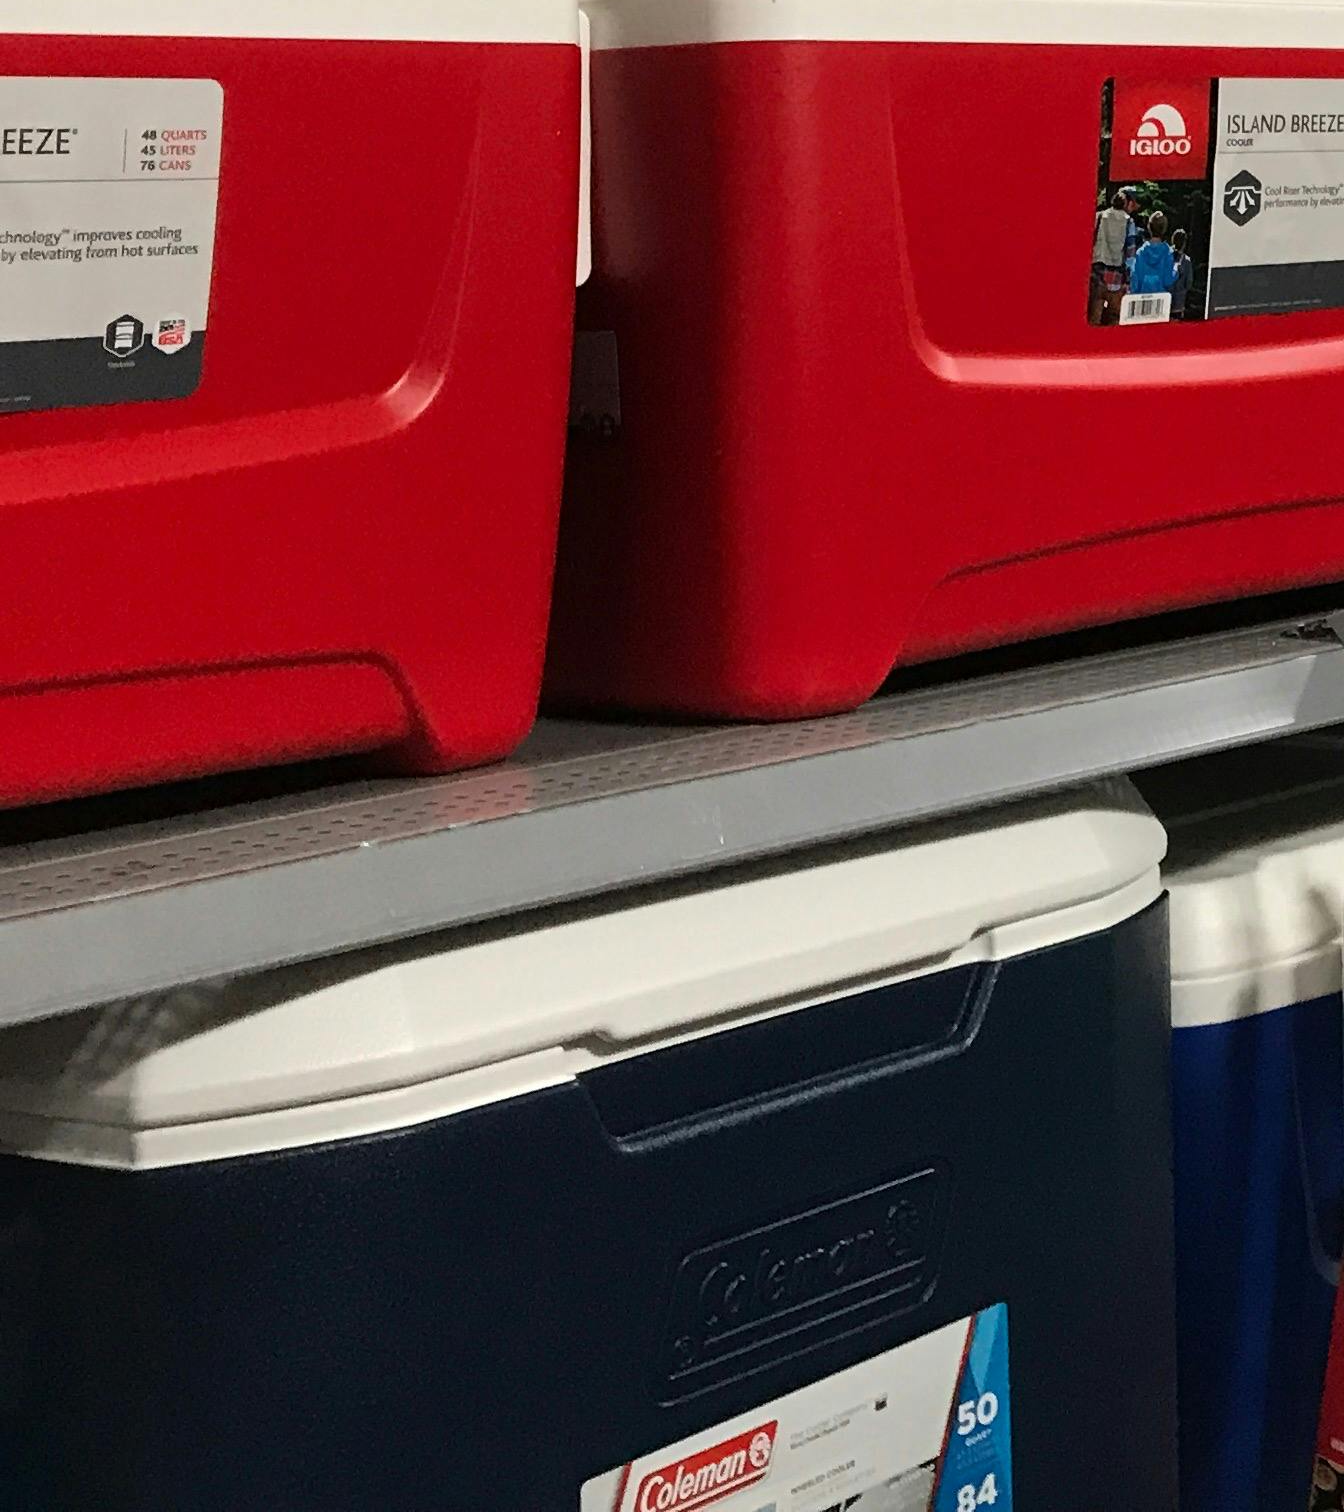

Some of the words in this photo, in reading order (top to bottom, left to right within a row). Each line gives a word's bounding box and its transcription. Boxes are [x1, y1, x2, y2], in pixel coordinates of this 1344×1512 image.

[1227, 114, 1286, 134] ISLAND
[141, 130, 157, 140] 48
[160, 129, 208, 142] QUARTS
[140, 144, 157, 155] 45
[159, 144, 197, 156] LITERS
[1129, 138, 1192, 156] IGLOO
[140, 160, 156, 171] 76
[158, 159, 192, 171] CANS
[1264, 187, 1282, 197] Cool
[1264, 198, 1309, 210] performance
[1309, 196, 1319, 208] by
[72, 229, 132, 248] improves
[136, 226, 183, 243] cooling
[20, 246, 83, 263] elevating
[85, 245, 118, 259] from
[121, 244, 144, 257] hot
[146, 242, 199, 256] surfaces
[957, 1392, 998, 1435] 50
[640, 1450, 747, 1512] Coleman
[957, 1472, 998, 1512] 84
